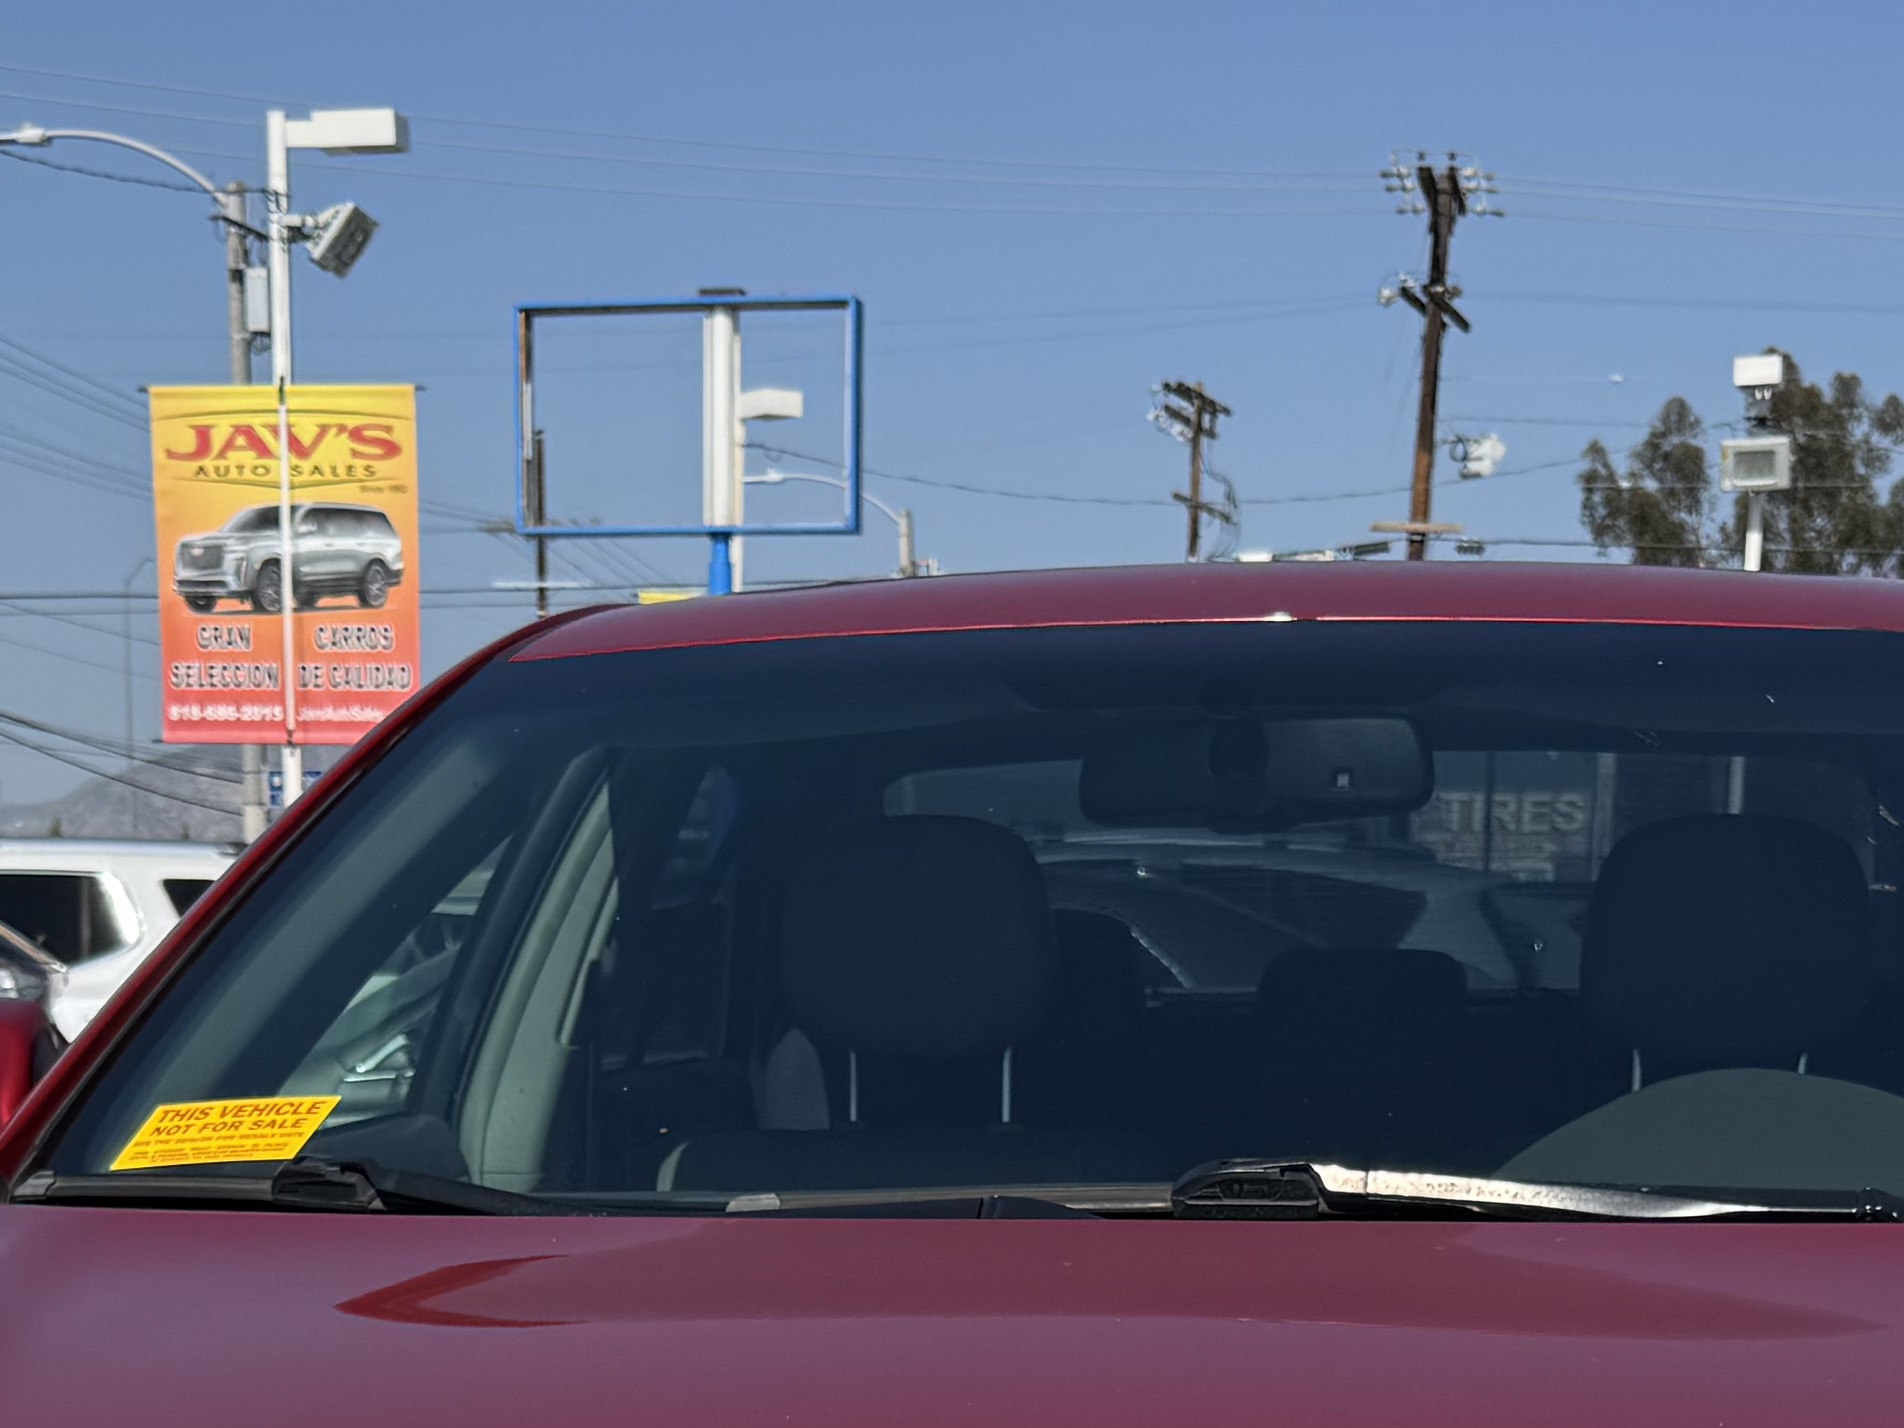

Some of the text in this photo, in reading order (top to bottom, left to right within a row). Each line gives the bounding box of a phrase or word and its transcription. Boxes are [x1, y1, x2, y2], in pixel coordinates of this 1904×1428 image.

[163, 422, 403, 463] JAV'S
[194, 463, 377, 478] AUTO SALES
[197, 624, 253, 651] GRAN
[313, 623, 395, 652] CARROS
[171, 662, 281, 690] SELECCION
[297, 663, 412, 692] DE CALIDAD
[1439, 791, 1586, 833] TIRES
[159, 1101, 326, 1123] THIS VEHICLE
[150, 1118, 306, 1136] NOT FOR SALE
